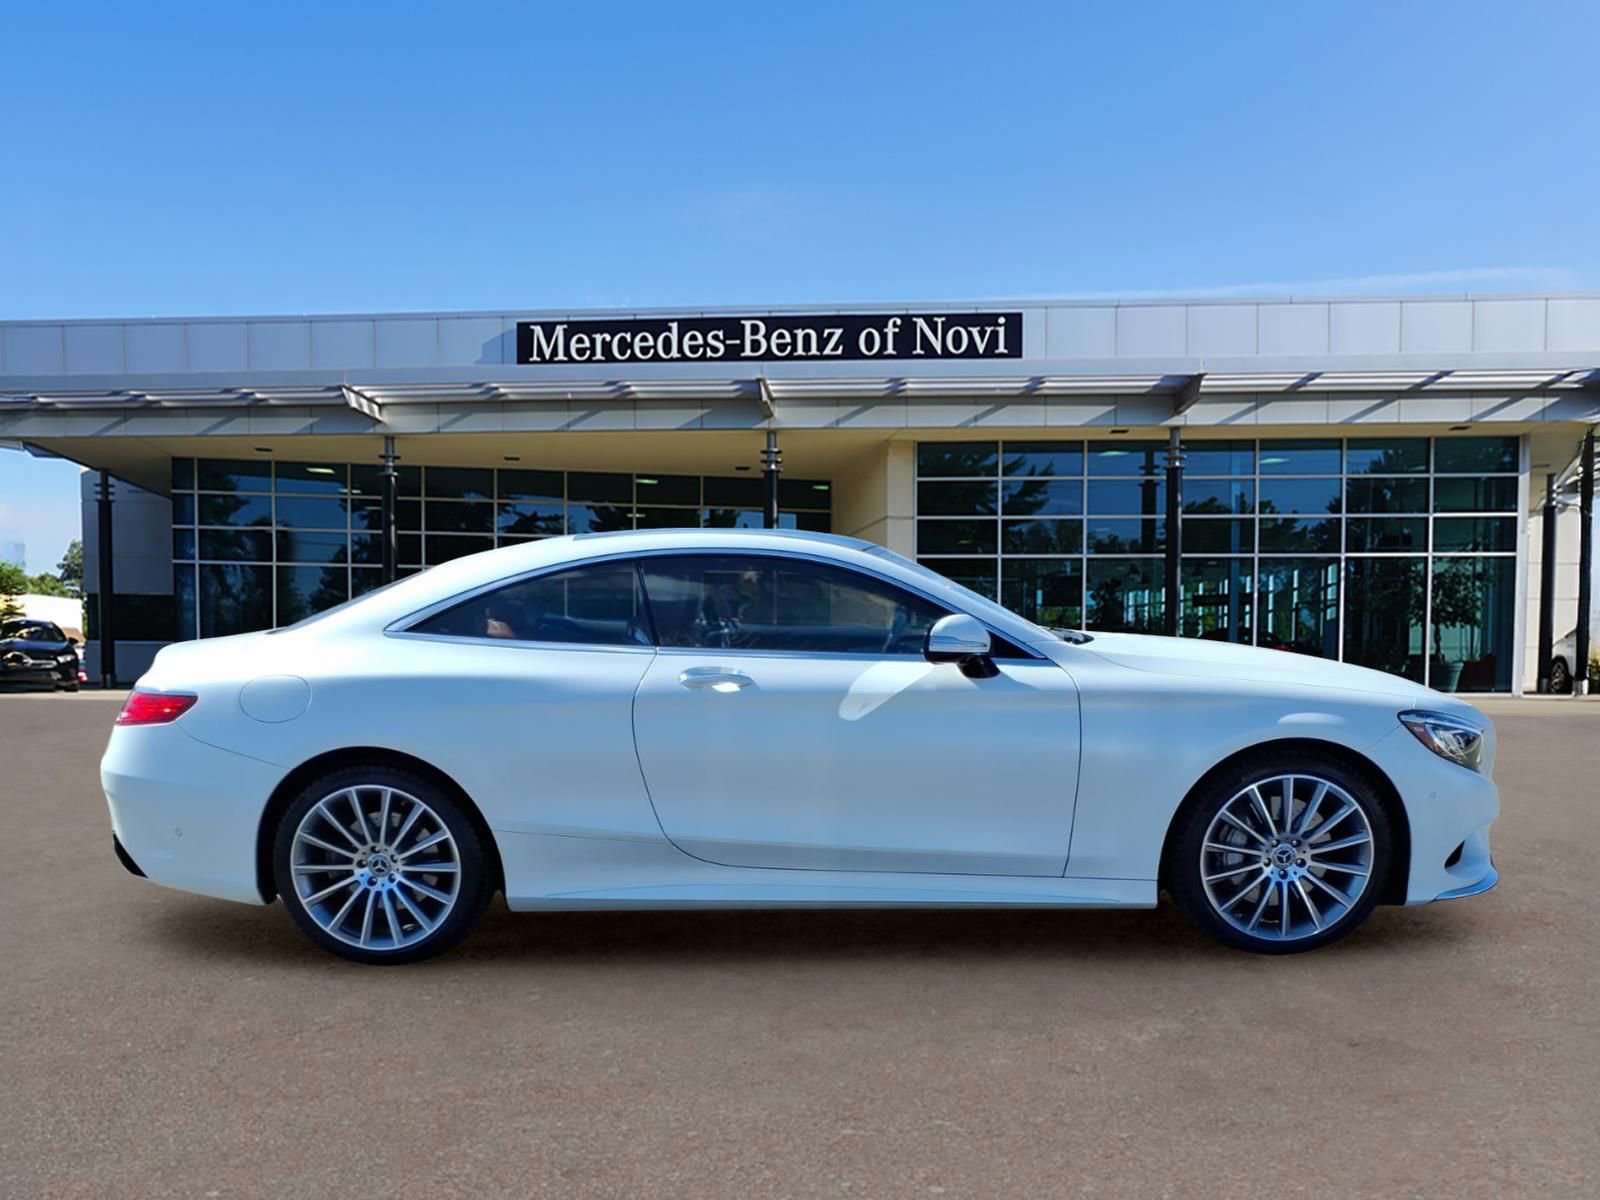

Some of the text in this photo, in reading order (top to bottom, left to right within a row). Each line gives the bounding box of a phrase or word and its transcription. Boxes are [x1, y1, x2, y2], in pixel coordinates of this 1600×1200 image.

[529, 316, 1009, 361] Mercedes-Benz of Novi
